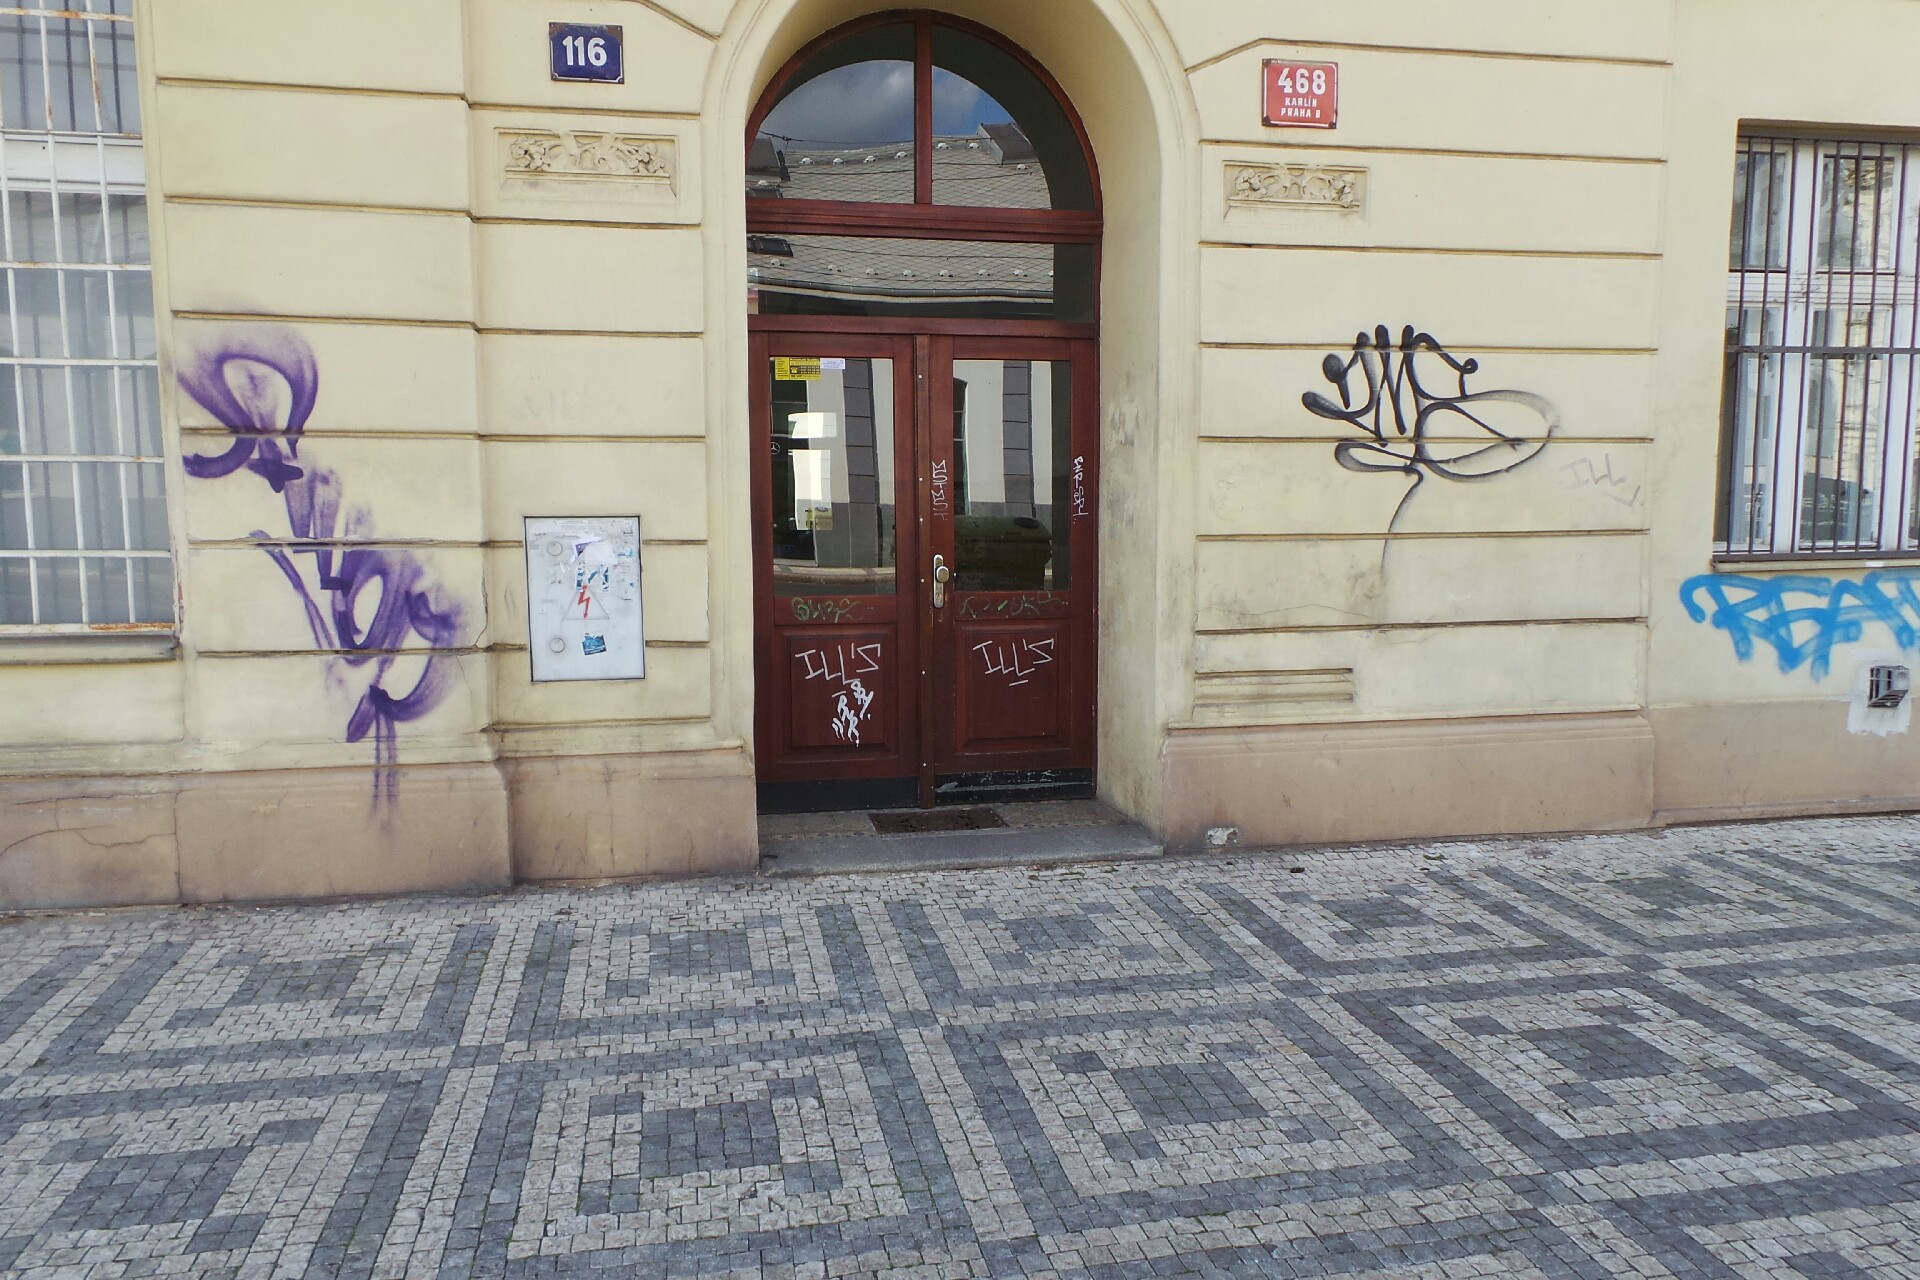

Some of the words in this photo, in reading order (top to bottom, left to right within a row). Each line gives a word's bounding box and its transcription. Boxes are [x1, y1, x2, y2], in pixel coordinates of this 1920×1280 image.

[562, 35, 607, 66] 116
[1277, 67, 1326, 95] 468
[1284, 96, 1318, 108] KARLÍN
[1280, 107, 1312, 118] PRAHA
